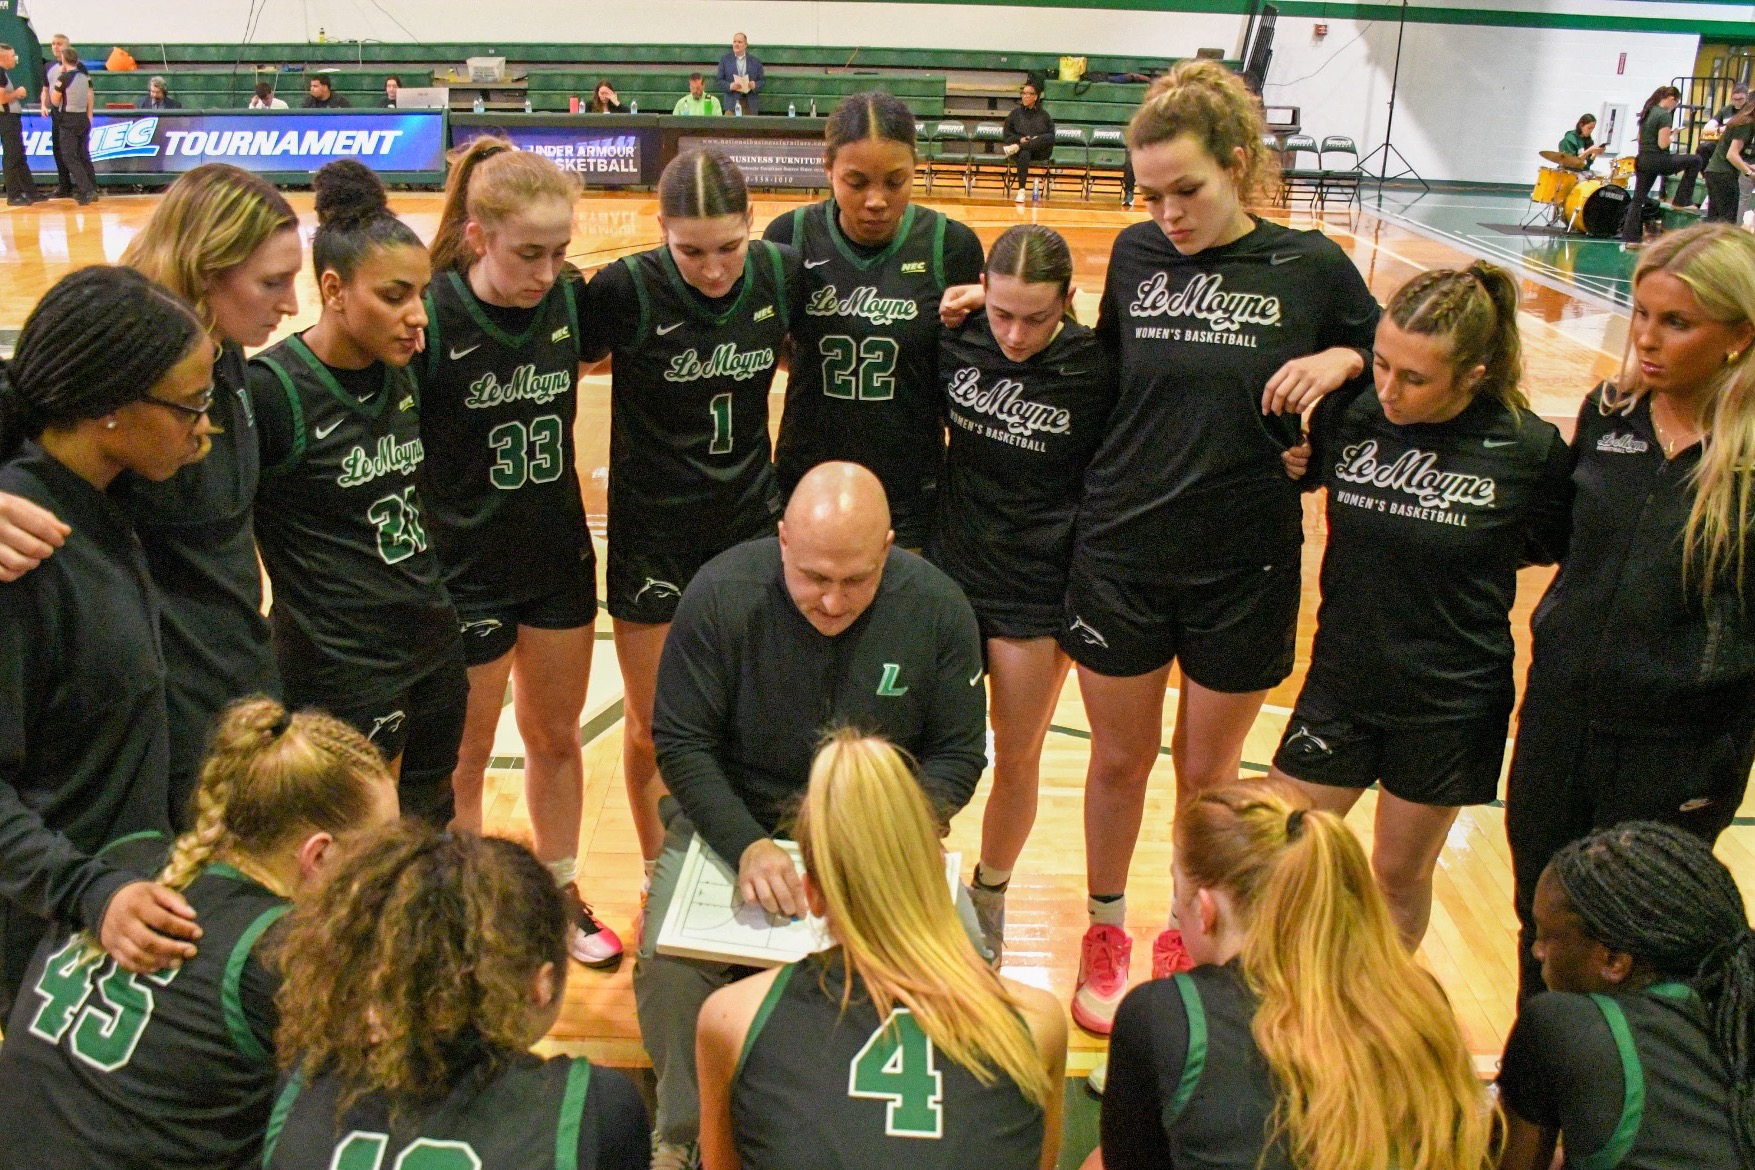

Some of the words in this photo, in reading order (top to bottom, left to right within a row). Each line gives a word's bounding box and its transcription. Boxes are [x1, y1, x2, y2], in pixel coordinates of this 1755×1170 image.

[165, 130, 404, 156] TOURNAMENT
[530, 145, 574, 157] UNDER
[576, 145, 635, 157] ARMOUR
[555, 158, 638, 172] SKETBALL
[1135, 327, 1181, 341] WOMEN'S
[1184, 329, 1258, 348] BASKETBALL
[819, 335, 899, 401] 22
[709, 392, 733, 455] 1
[950, 408, 984, 435] WOMEN'S
[985, 426, 1046, 453] BASKETBALL
[488, 414, 563, 490] 33
[1337, 490, 1386, 512] WOMEN'S
[1389, 502, 1467, 527] BASKETBALL
[876, 663, 909, 696] L
[29, 933, 181, 1072] 45
[848, 1008, 943, 1139] 4
